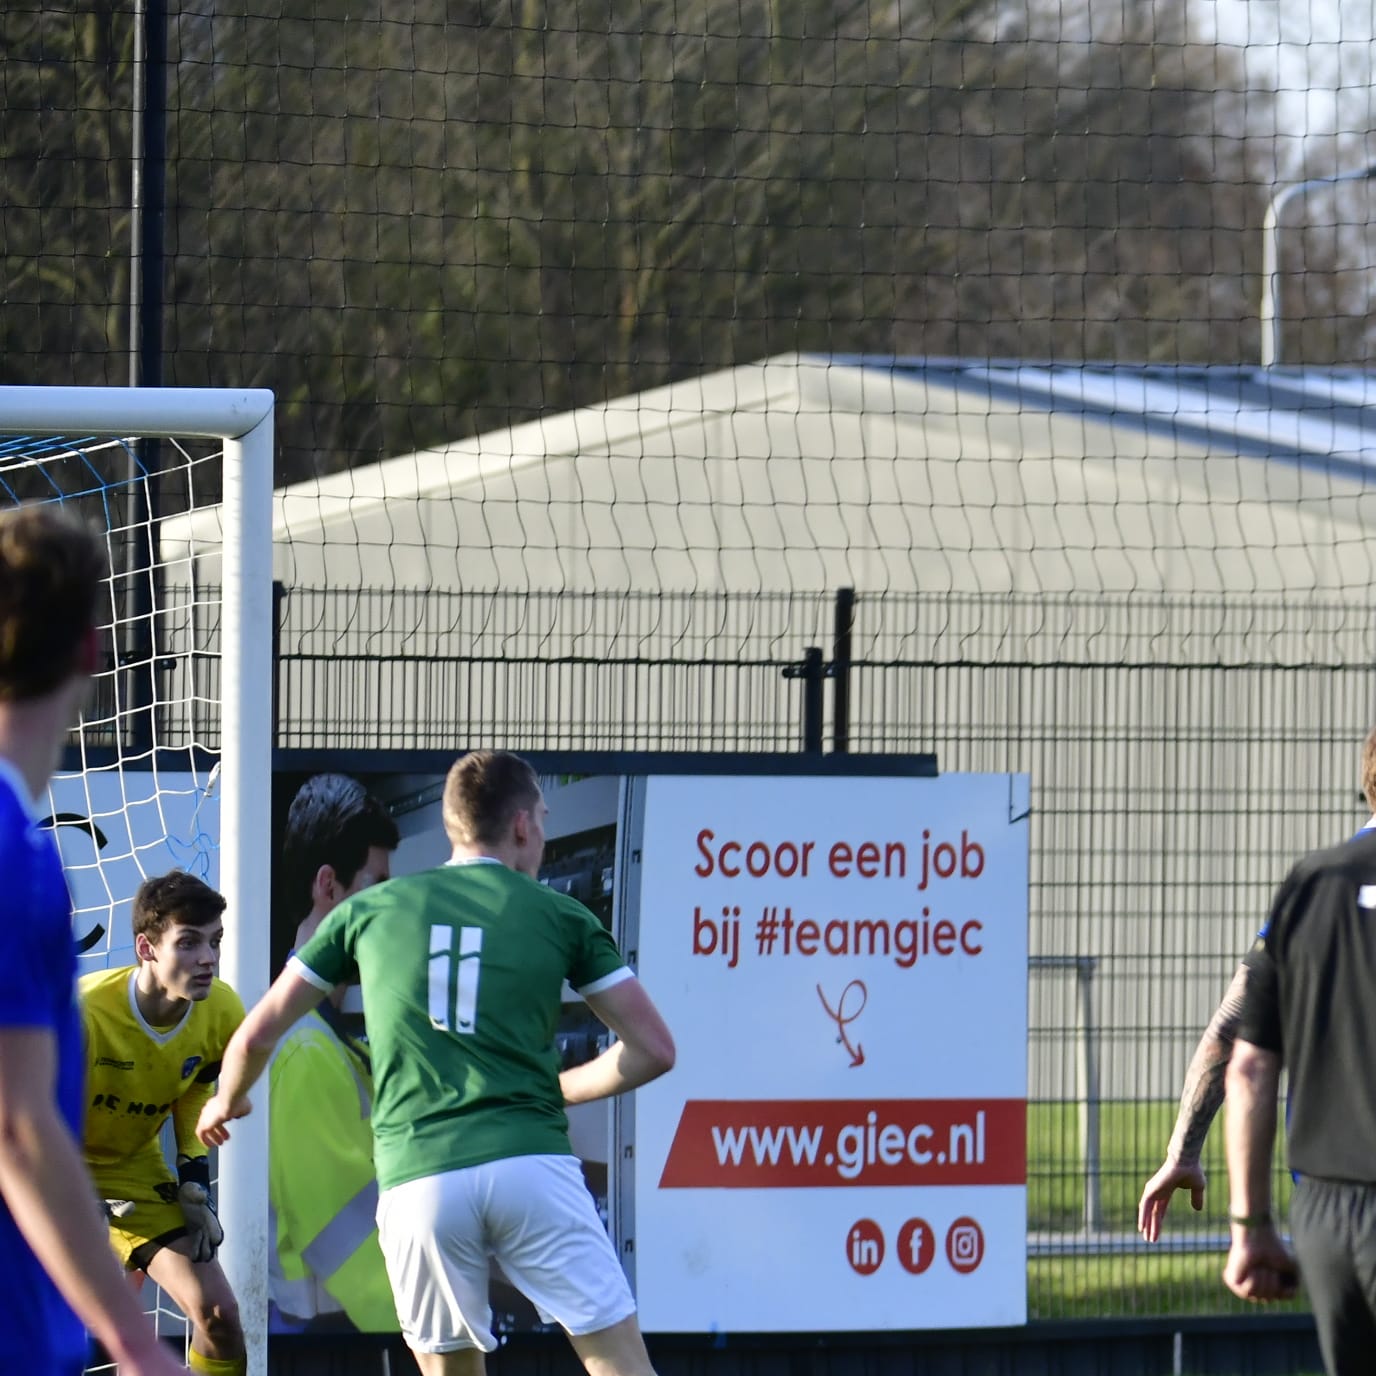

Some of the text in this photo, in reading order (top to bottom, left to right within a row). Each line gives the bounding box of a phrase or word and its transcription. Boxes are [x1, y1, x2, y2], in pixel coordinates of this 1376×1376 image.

[694, 828, 985, 891] Scoor een job
[692, 906, 983, 968] bij #teamgiec
[427, 924, 483, 1034] 11
[711, 1110, 986, 1179] www.giec.nl
